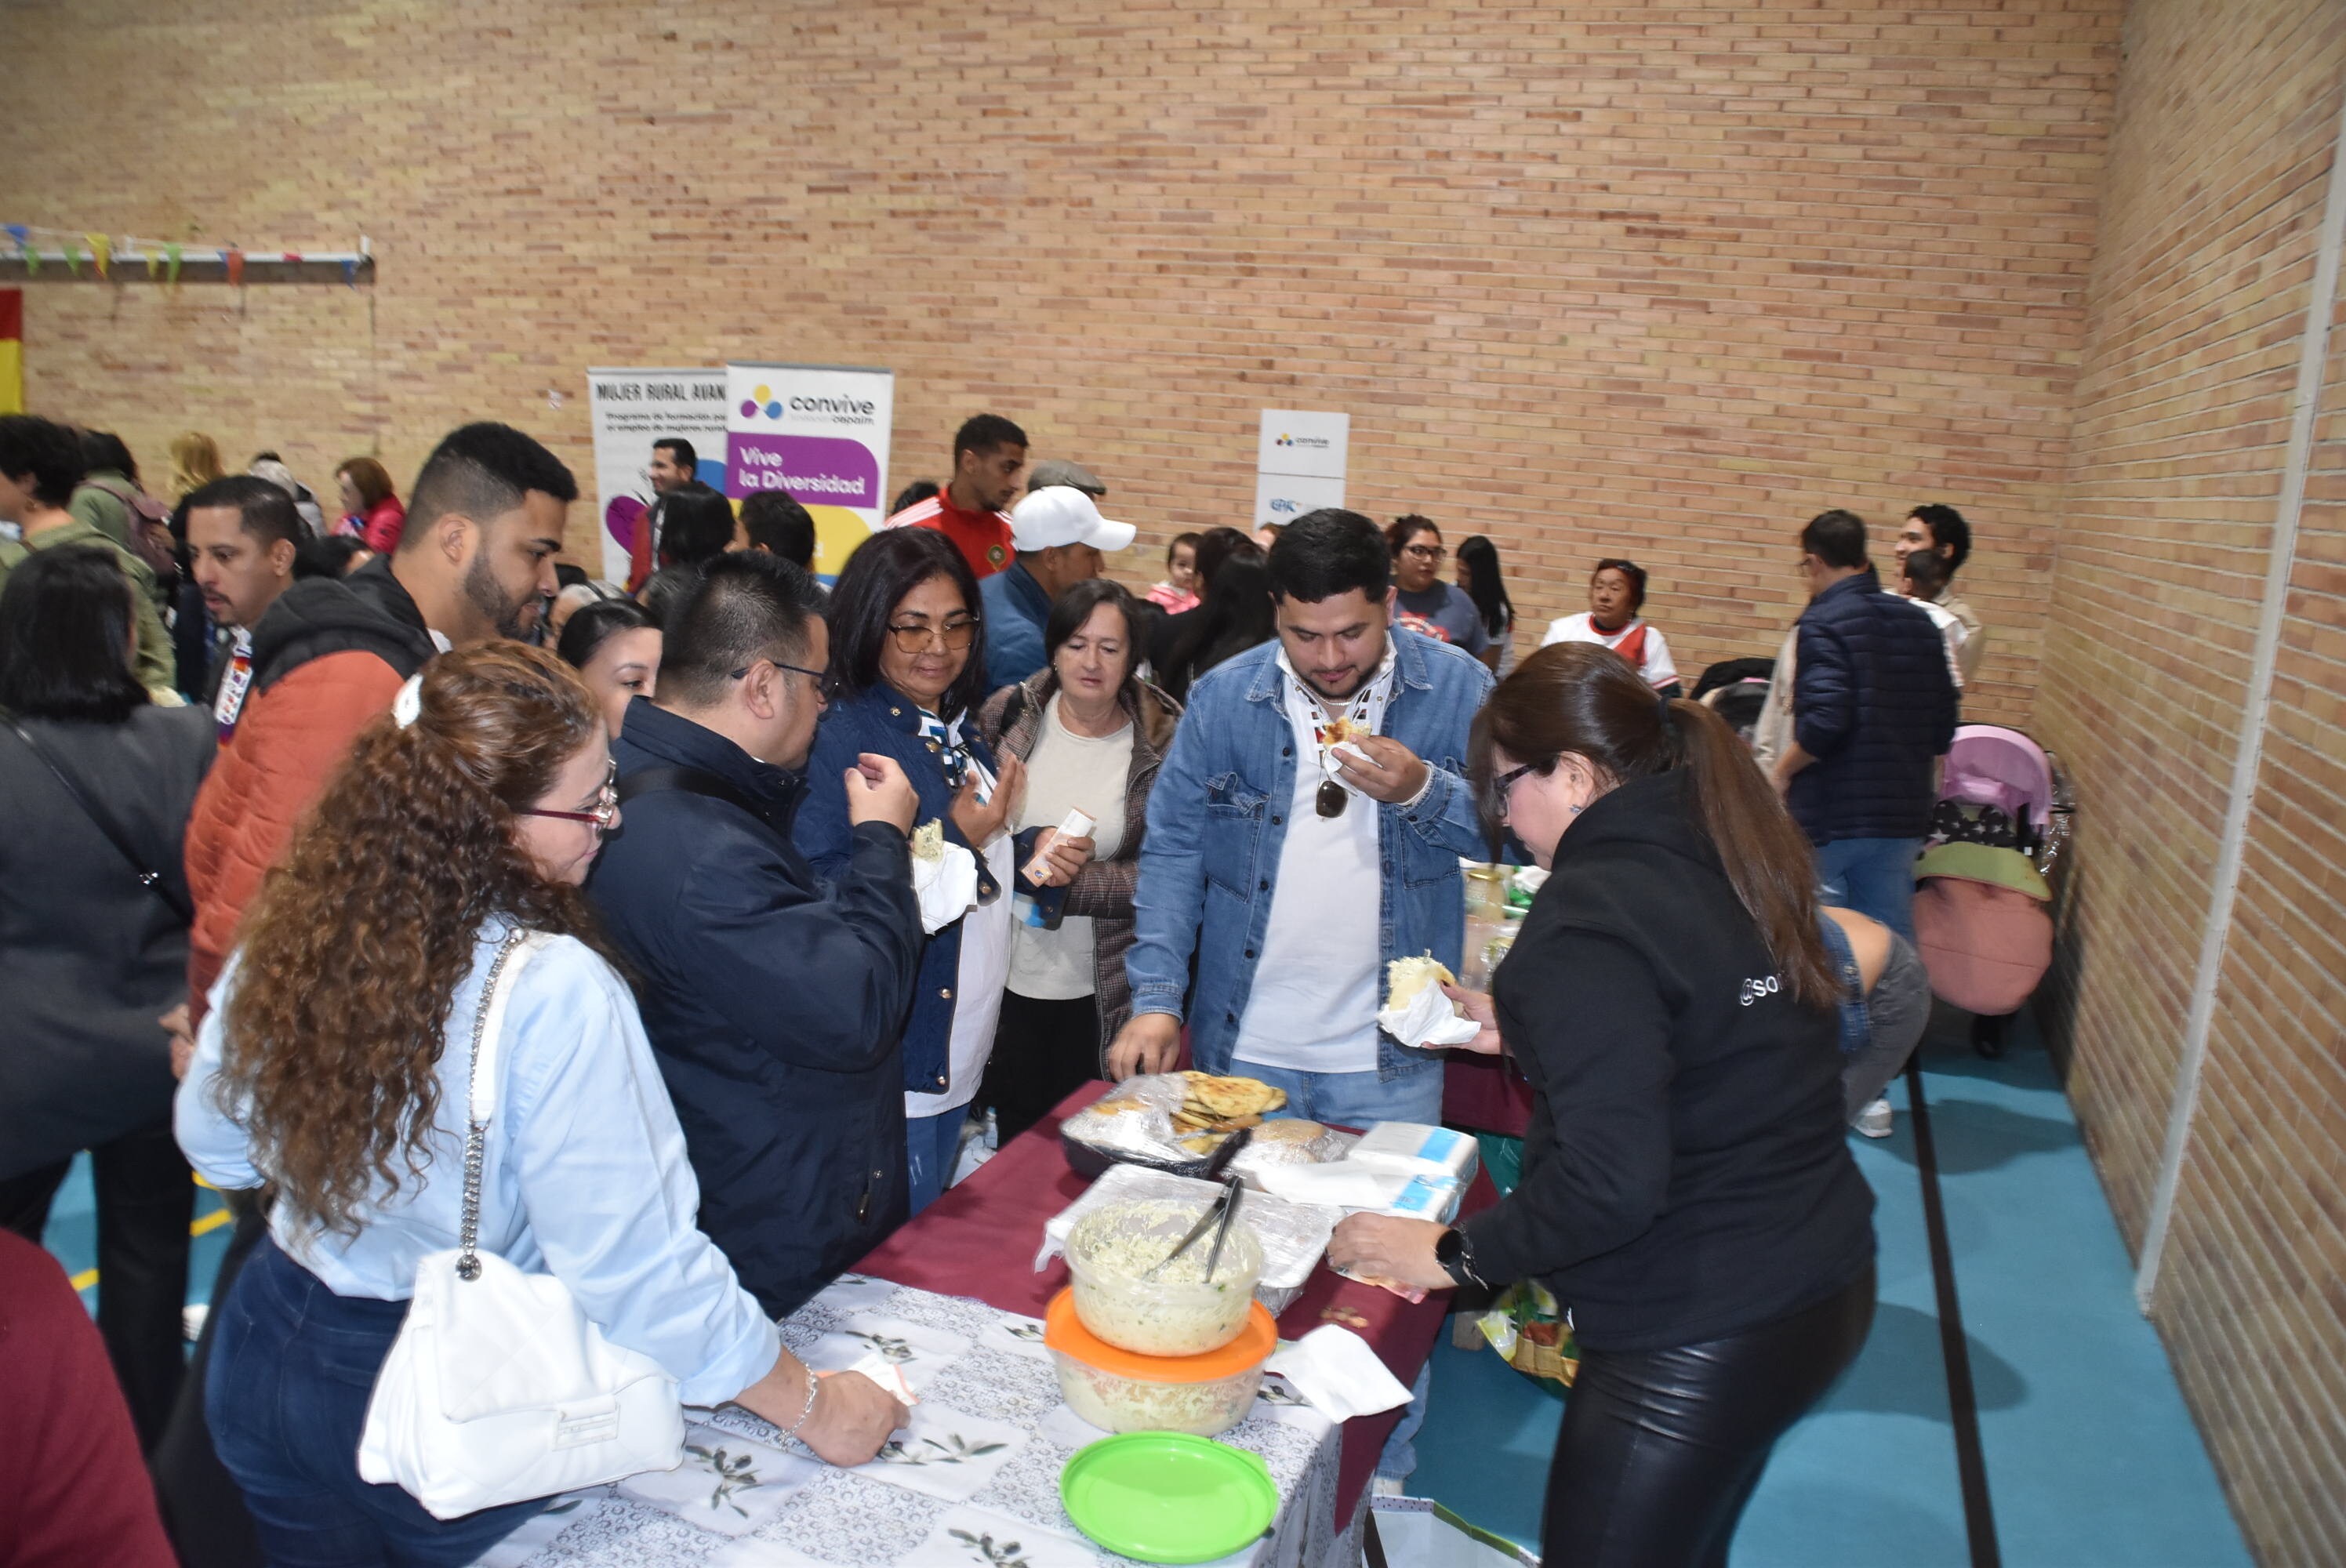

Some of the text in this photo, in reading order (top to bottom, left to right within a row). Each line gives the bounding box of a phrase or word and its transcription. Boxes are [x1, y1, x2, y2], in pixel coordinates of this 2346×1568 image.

[597, 383, 641, 401] MUJER
[645, 382, 688, 401] RURAL
[790, 394, 876, 415] convive
[739, 446, 783, 467] Vive
[739, 468, 866, 495] la Diversidad
